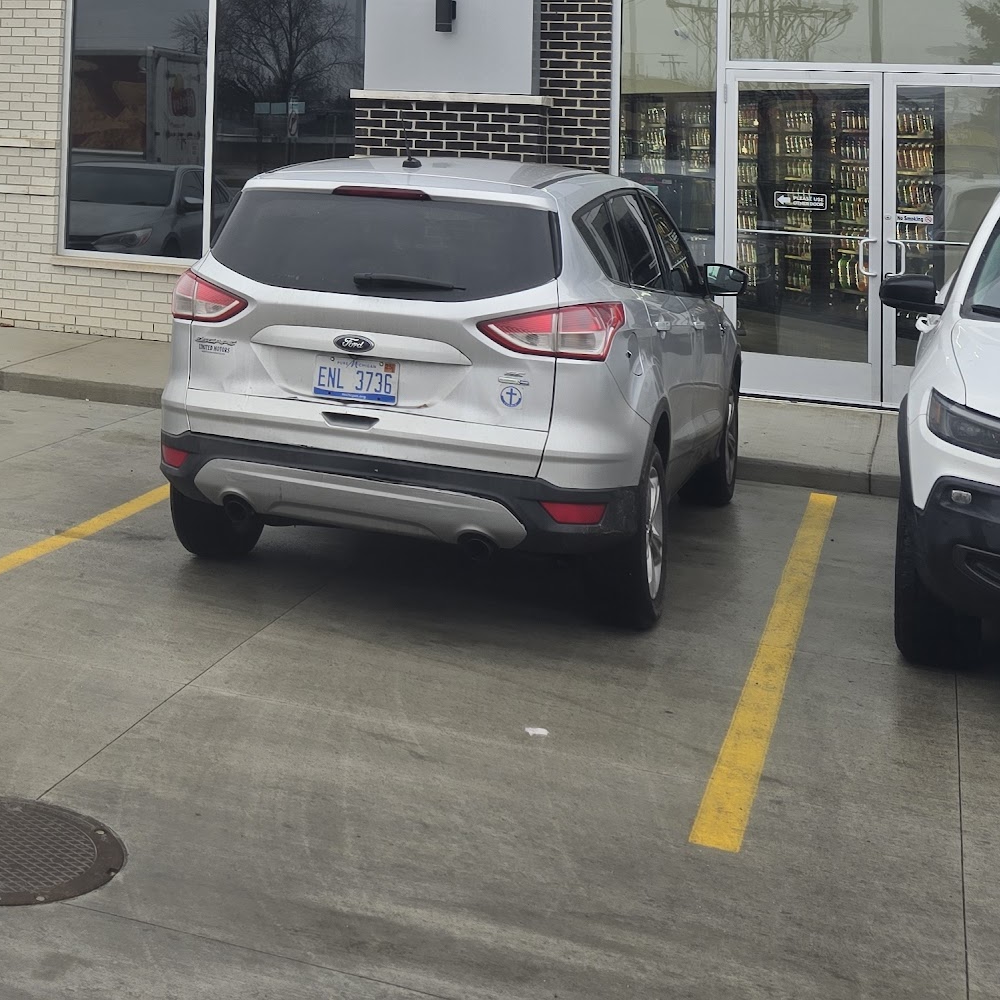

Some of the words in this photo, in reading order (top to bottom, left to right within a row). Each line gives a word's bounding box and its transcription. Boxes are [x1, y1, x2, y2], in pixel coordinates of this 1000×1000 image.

[341, 337, 365, 349] Ford
[317, 365, 345, 390] ENL
[355, 370, 393, 395] 3736
